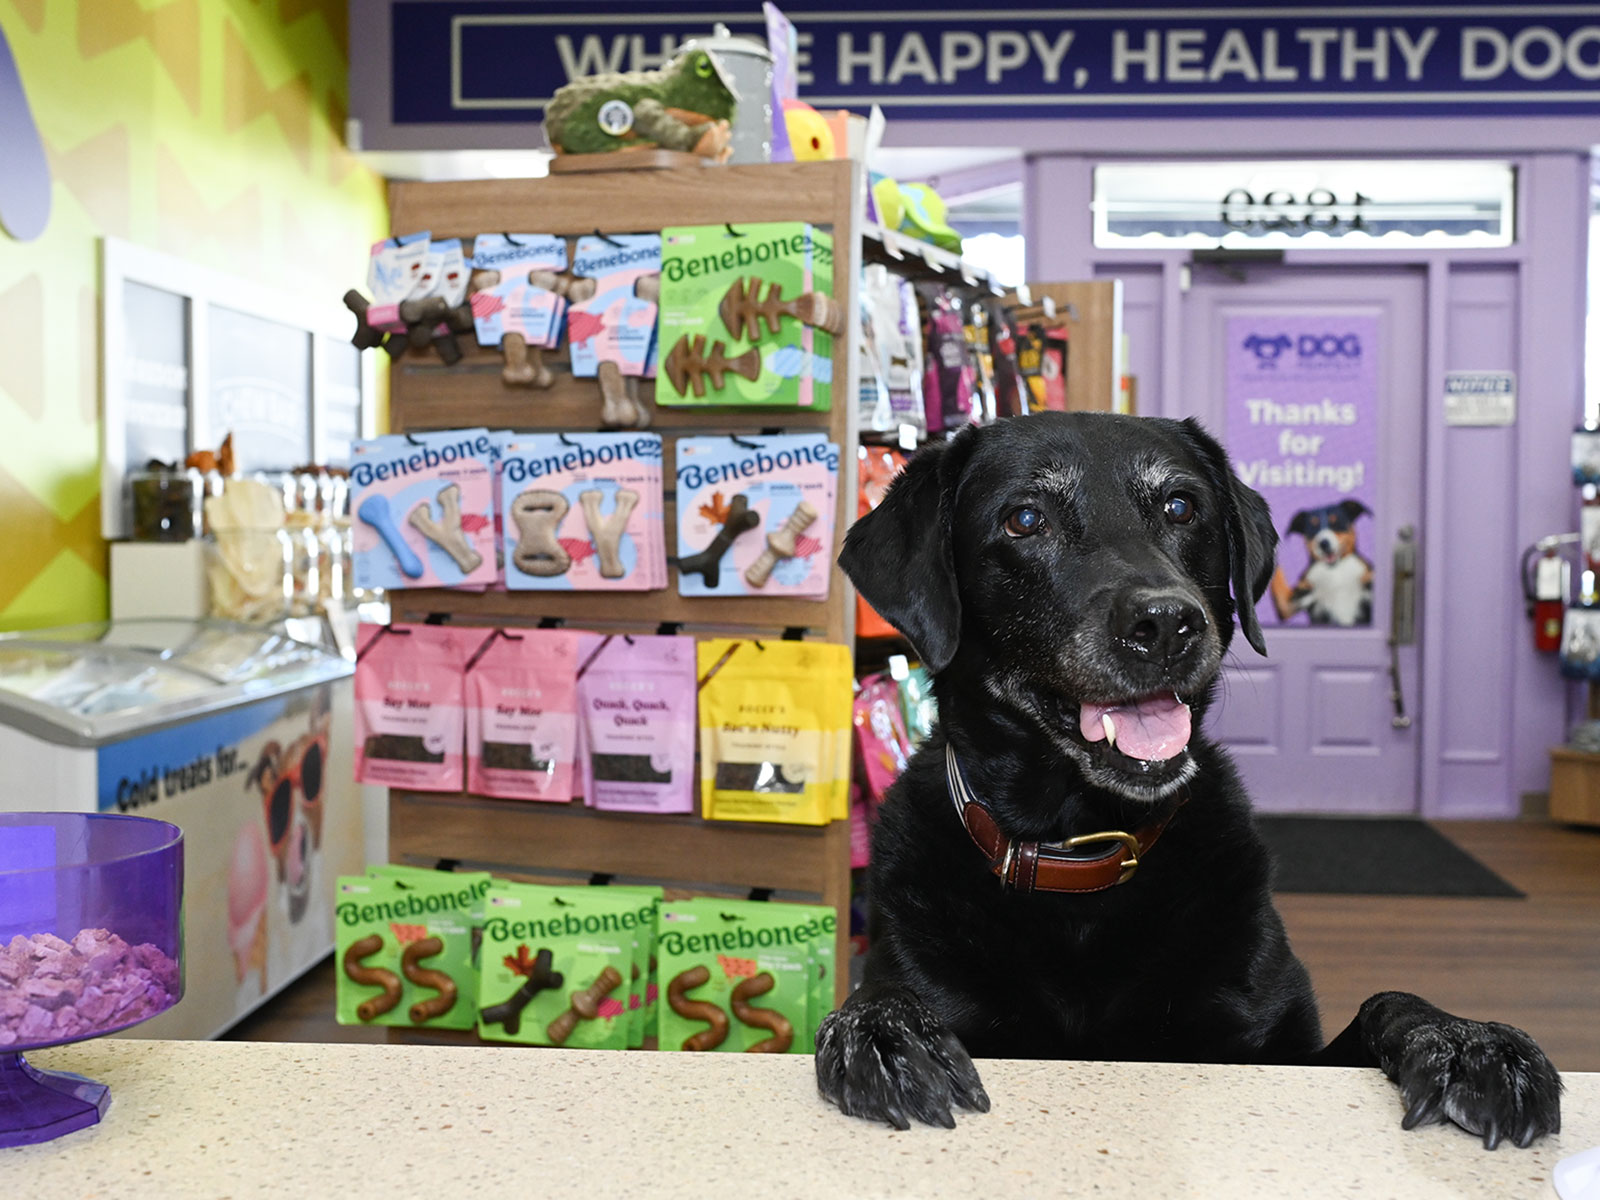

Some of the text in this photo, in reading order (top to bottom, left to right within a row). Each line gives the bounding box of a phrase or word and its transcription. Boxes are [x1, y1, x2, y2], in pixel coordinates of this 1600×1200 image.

[836, 31, 1089, 88] HAPPY,
[1112, 28, 1438, 83] HEALTHY
[662, 234, 806, 282] Benebone
[1298, 333, 1362, 358] DOG
[1246, 399, 1357, 425] Thanks
[502, 437, 650, 482] Benebone
[1279, 429, 1324, 456] for
[350, 436, 491, 487] Benebone
[677, 442, 828, 489] Benebone
[1236, 459, 1365, 492] Visiting!
[614, 713, 648, 727] Quack
[117, 766, 160, 812] Cold
[164, 756, 213, 797] treats
[336, 890, 470, 926] Benebone
[484, 912, 637, 942] Benebone
[657, 923, 811, 955] Benebone
